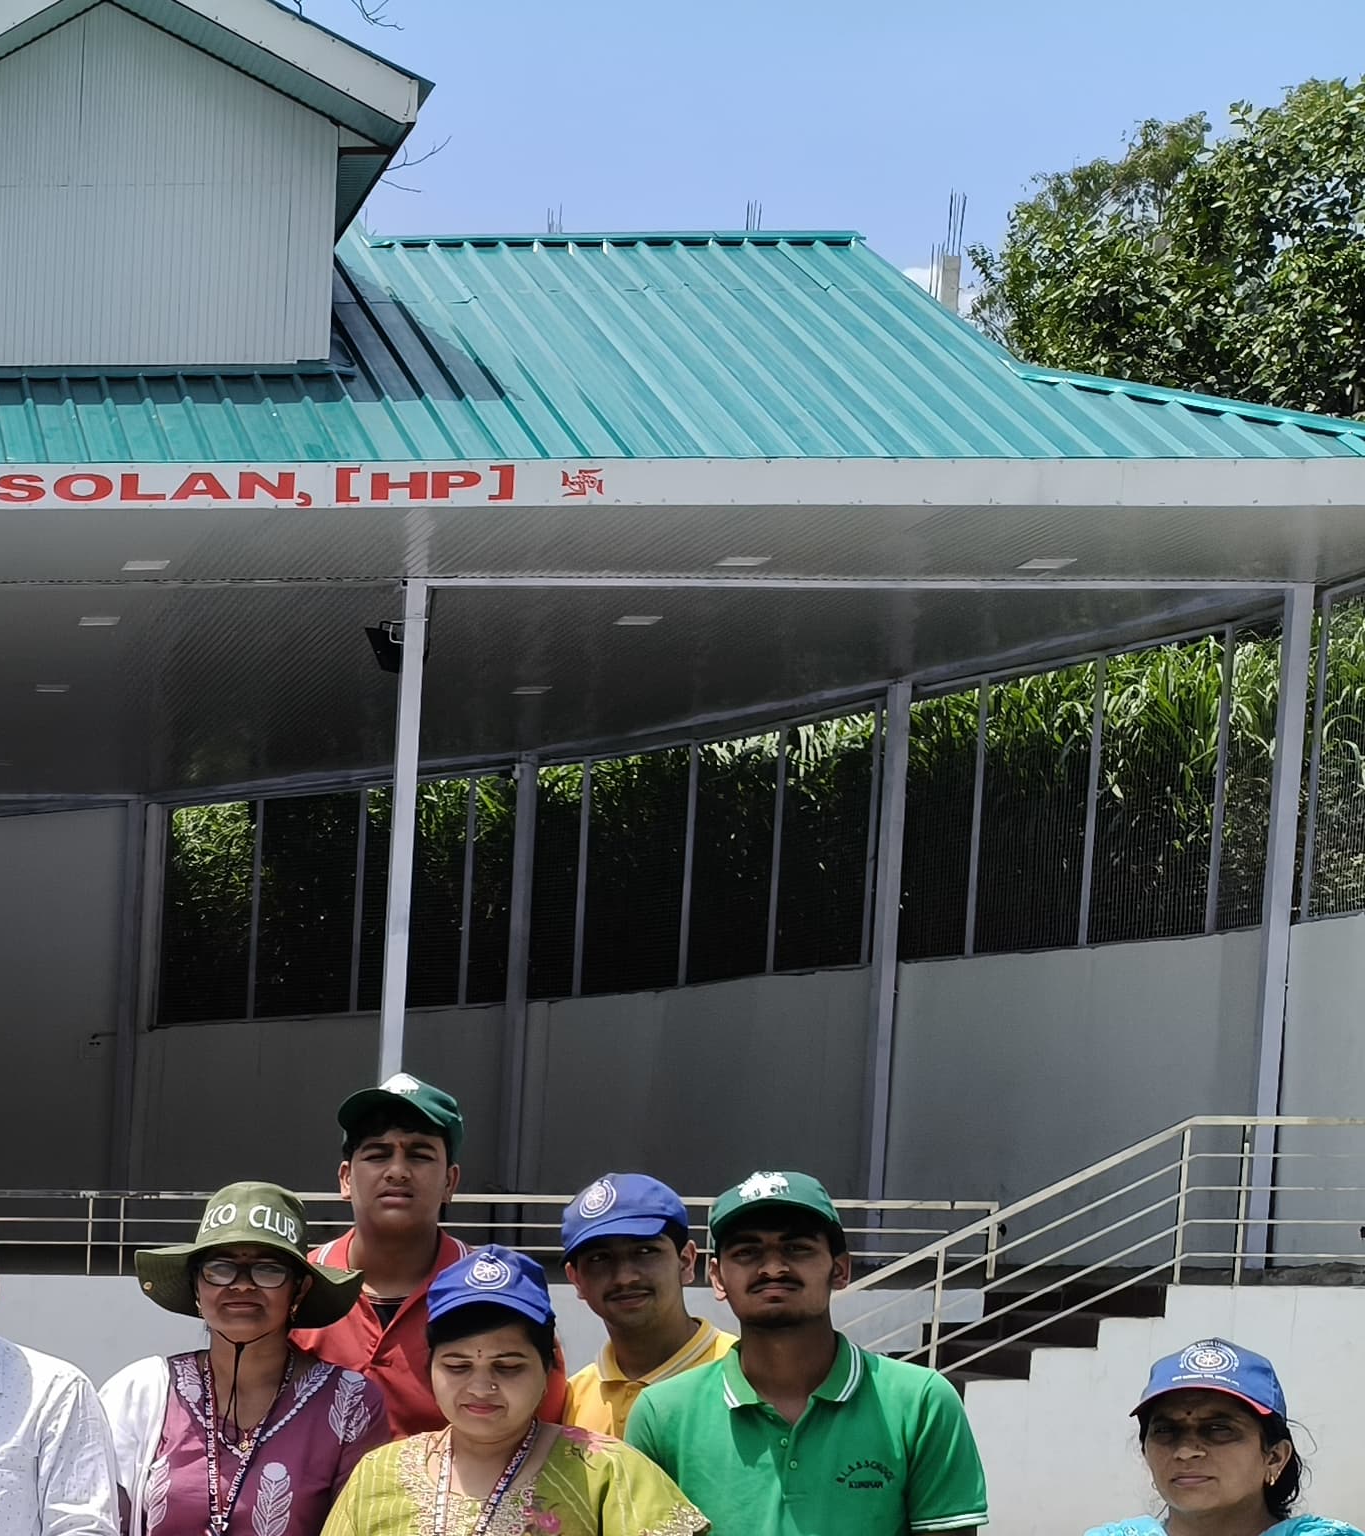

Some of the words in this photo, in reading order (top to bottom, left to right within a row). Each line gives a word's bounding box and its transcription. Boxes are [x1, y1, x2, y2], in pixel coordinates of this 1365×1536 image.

[202, 1203, 237, 1234] ECO
[249, 1205, 298, 1244] CLUB
[226, 1466, 246, 1502] CENTRAL
